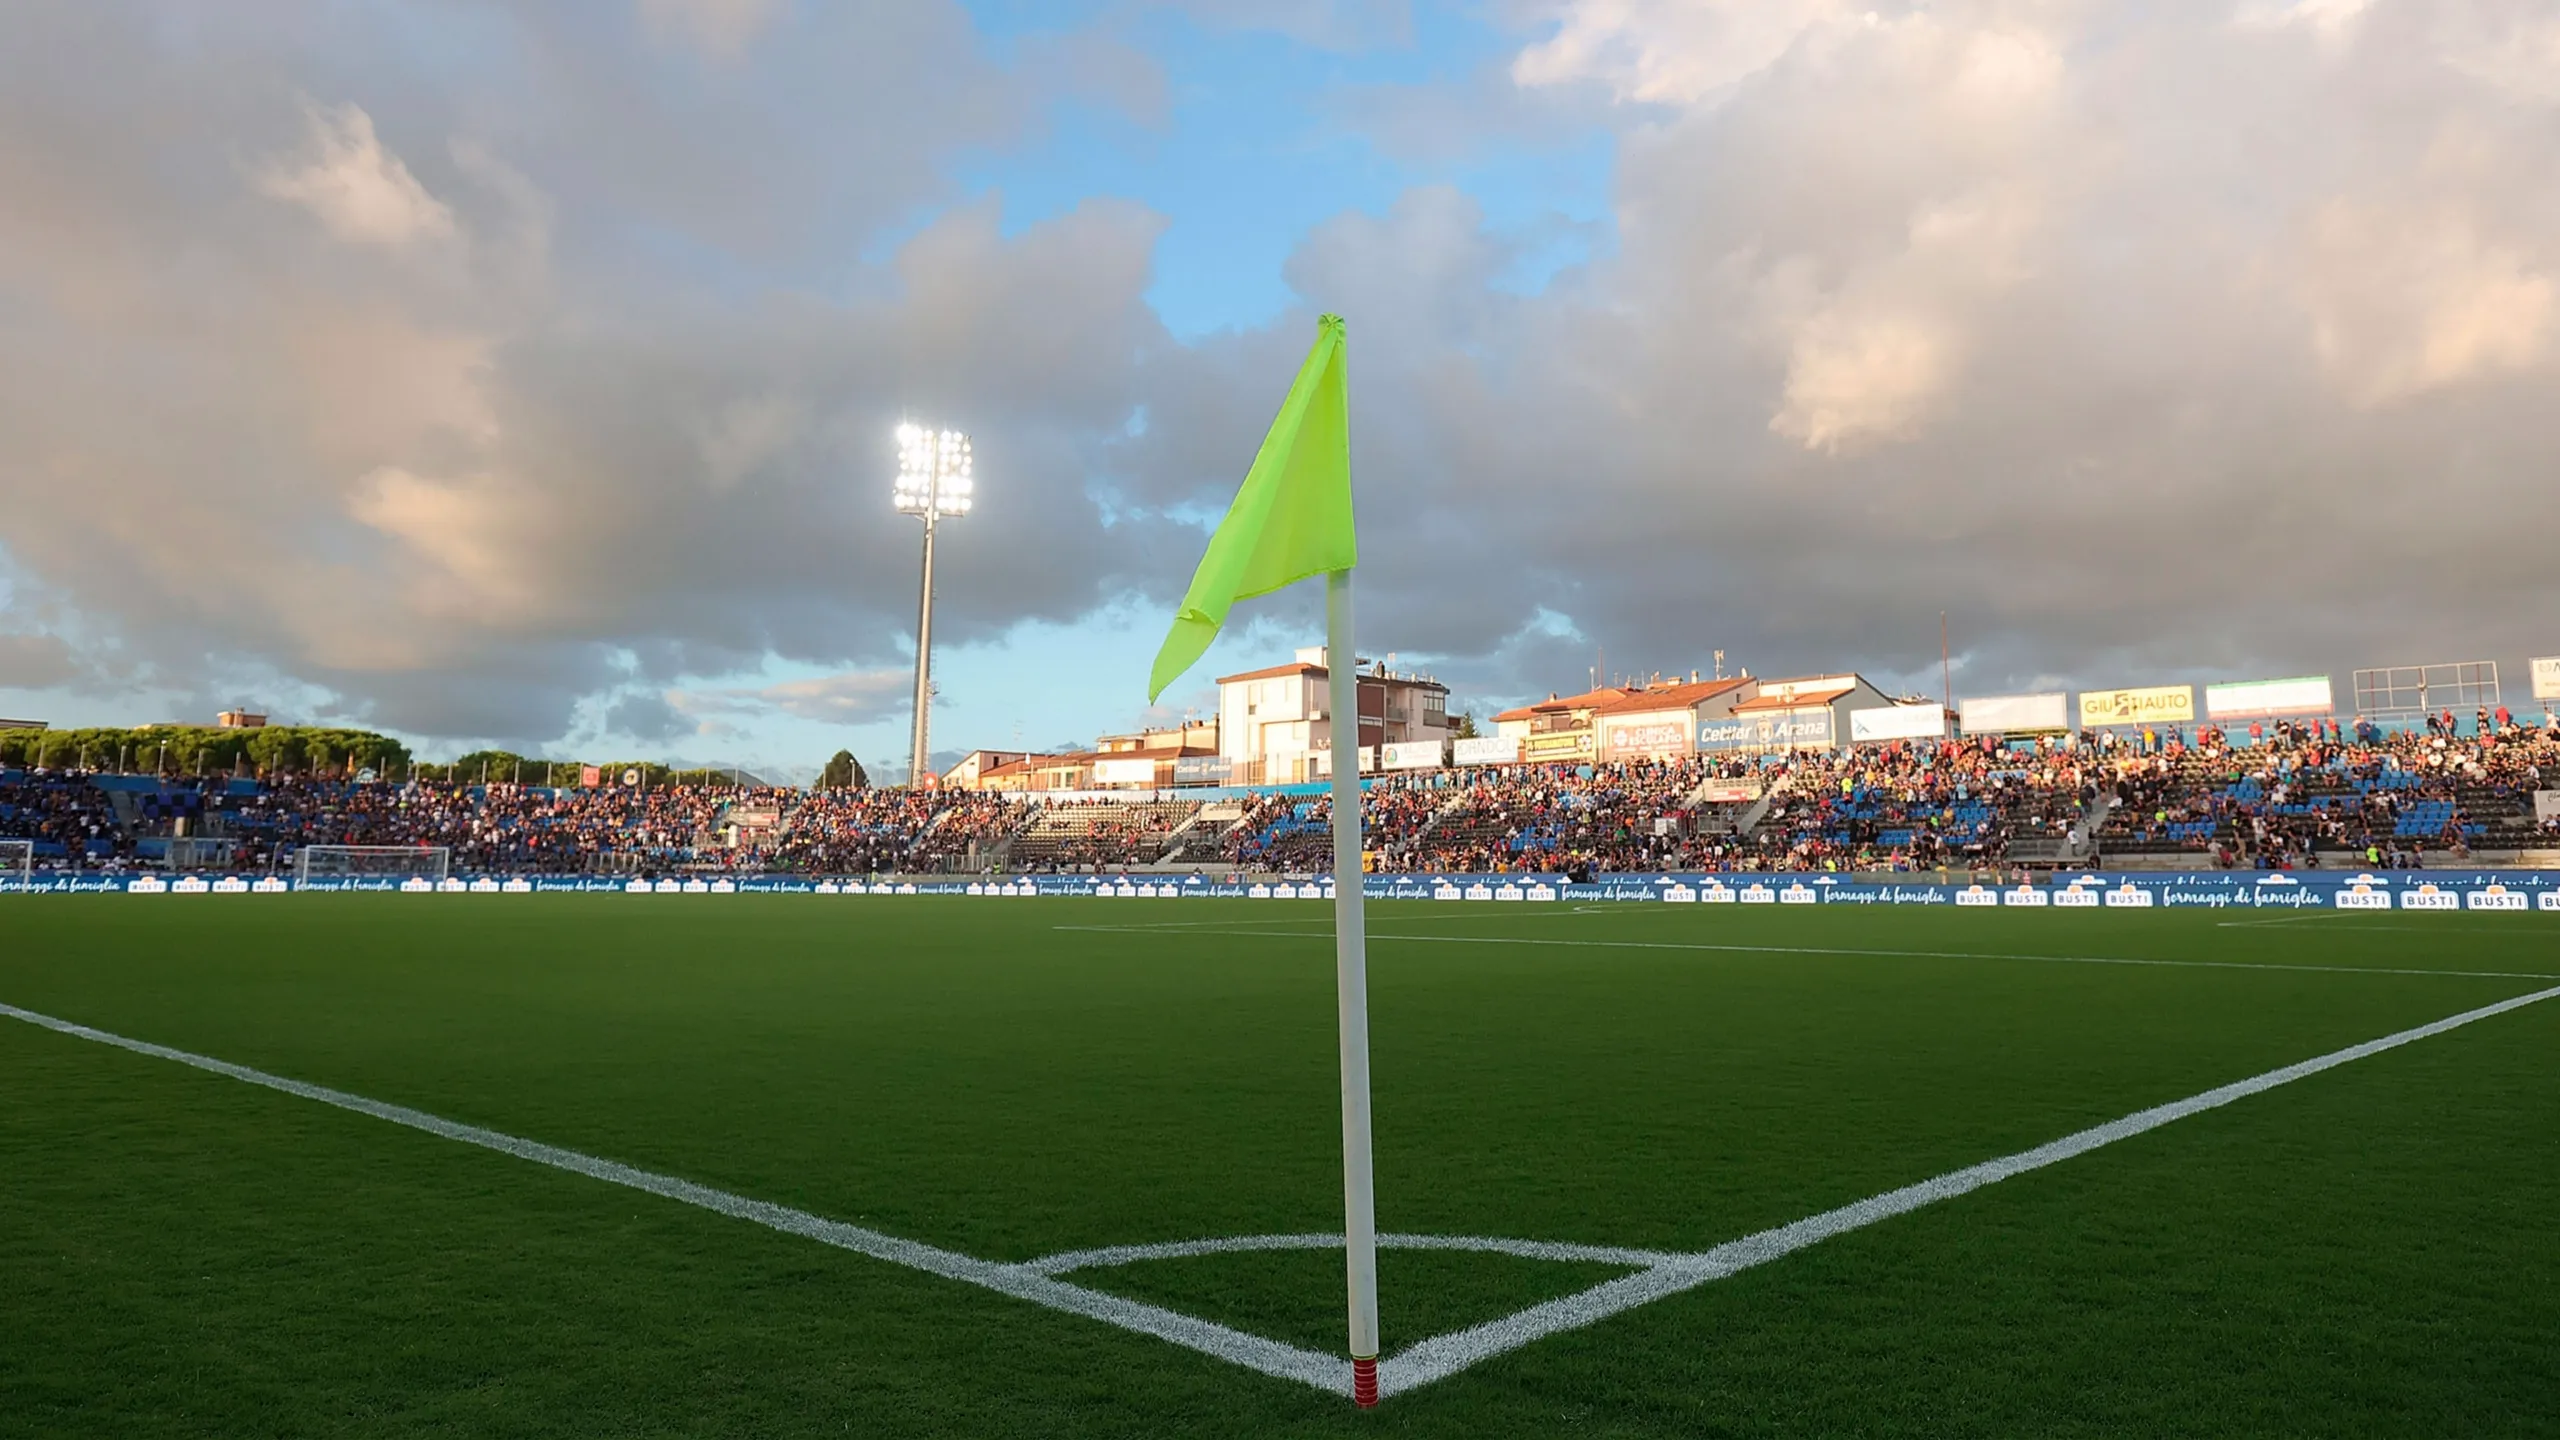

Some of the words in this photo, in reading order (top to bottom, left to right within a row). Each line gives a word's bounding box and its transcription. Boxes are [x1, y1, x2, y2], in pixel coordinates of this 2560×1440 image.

[1635, 726, 1676, 737] CLINICA
[1701, 727, 1752, 743] Cetilar
[1776, 721, 1826, 738] Arena
[1362, 889, 1386, 899] maggi
[1387, 885, 1395, 897] di
[1396, 885, 1430, 899] famiglia
[1561, 885, 1602, 901] formaggi
[1604, 886, 1615, 899] di
[1616, 885, 1657, 901] famiglia
[1824, 885, 1877, 904] formaggi
[1879, 886, 1893, 901] di
[1893, 886, 1946, 904] famiglia
[2163, 886, 2232, 908] formaggi
[2234, 887, 2252, 903] di
[2254, 886, 2323, 908] famiglia
[1960, 895, 1993, 903] BUSTI
[2009, 895, 2043, 903] BUSTI
[2058, 895, 2094, 903] BUSTI
[2111, 895, 2147, 903] BUSTI
[2341, 896, 2386, 904] BUSTI
[2407, 896, 2453, 906] BUSTI
[2474, 896, 2523, 906] BUSTI
